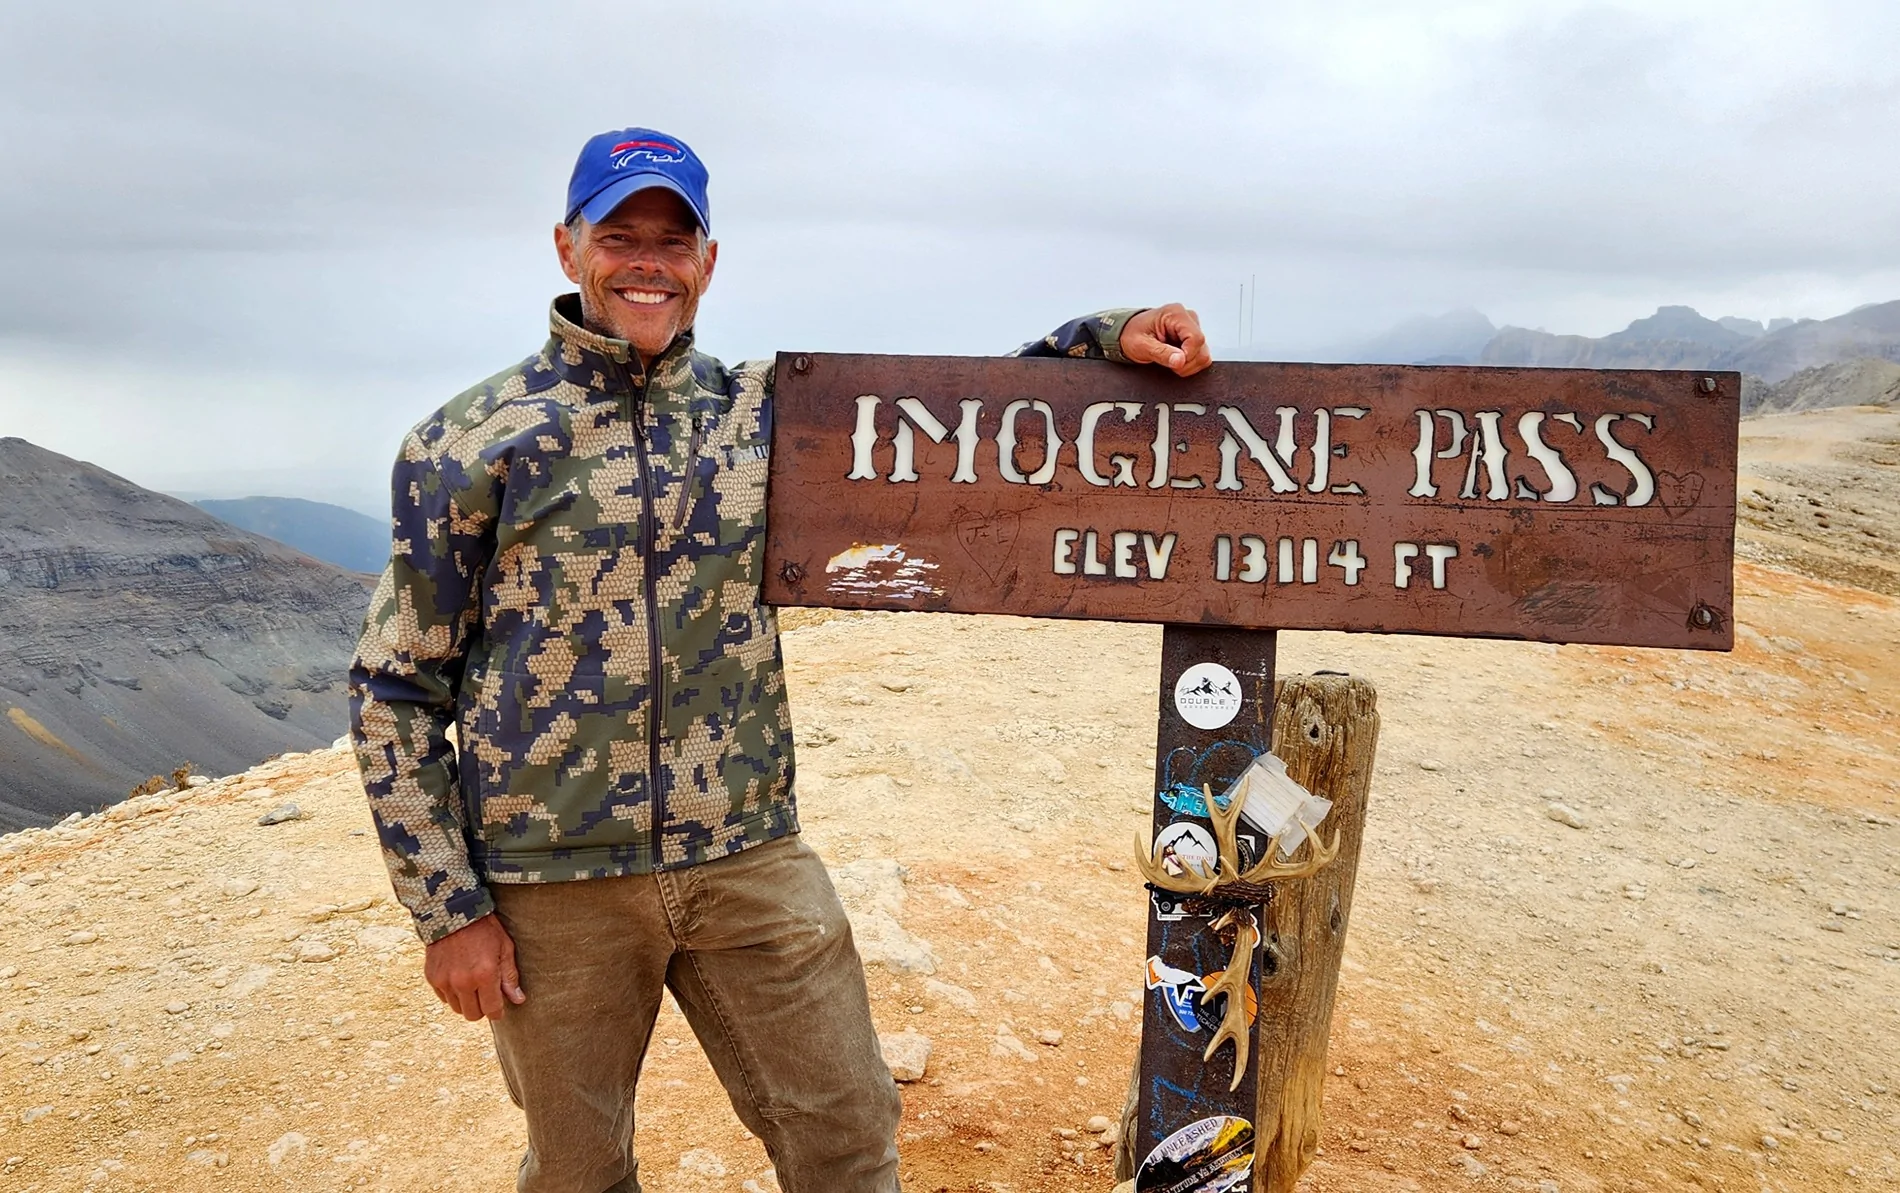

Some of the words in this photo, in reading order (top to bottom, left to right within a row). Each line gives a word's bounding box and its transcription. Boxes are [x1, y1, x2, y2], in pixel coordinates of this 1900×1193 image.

[846, 394, 1371, 496] IMOGENE
[1408, 408, 1656, 508] PASS
[1053, 528, 1178, 582] ELEV
[1214, 534, 1368, 588] 13114
[1393, 540, 1460, 591] FT
[1180, 697, 1226, 706] DOUBLE
[1160, 1118, 1218, 1156] UNLEASHED
